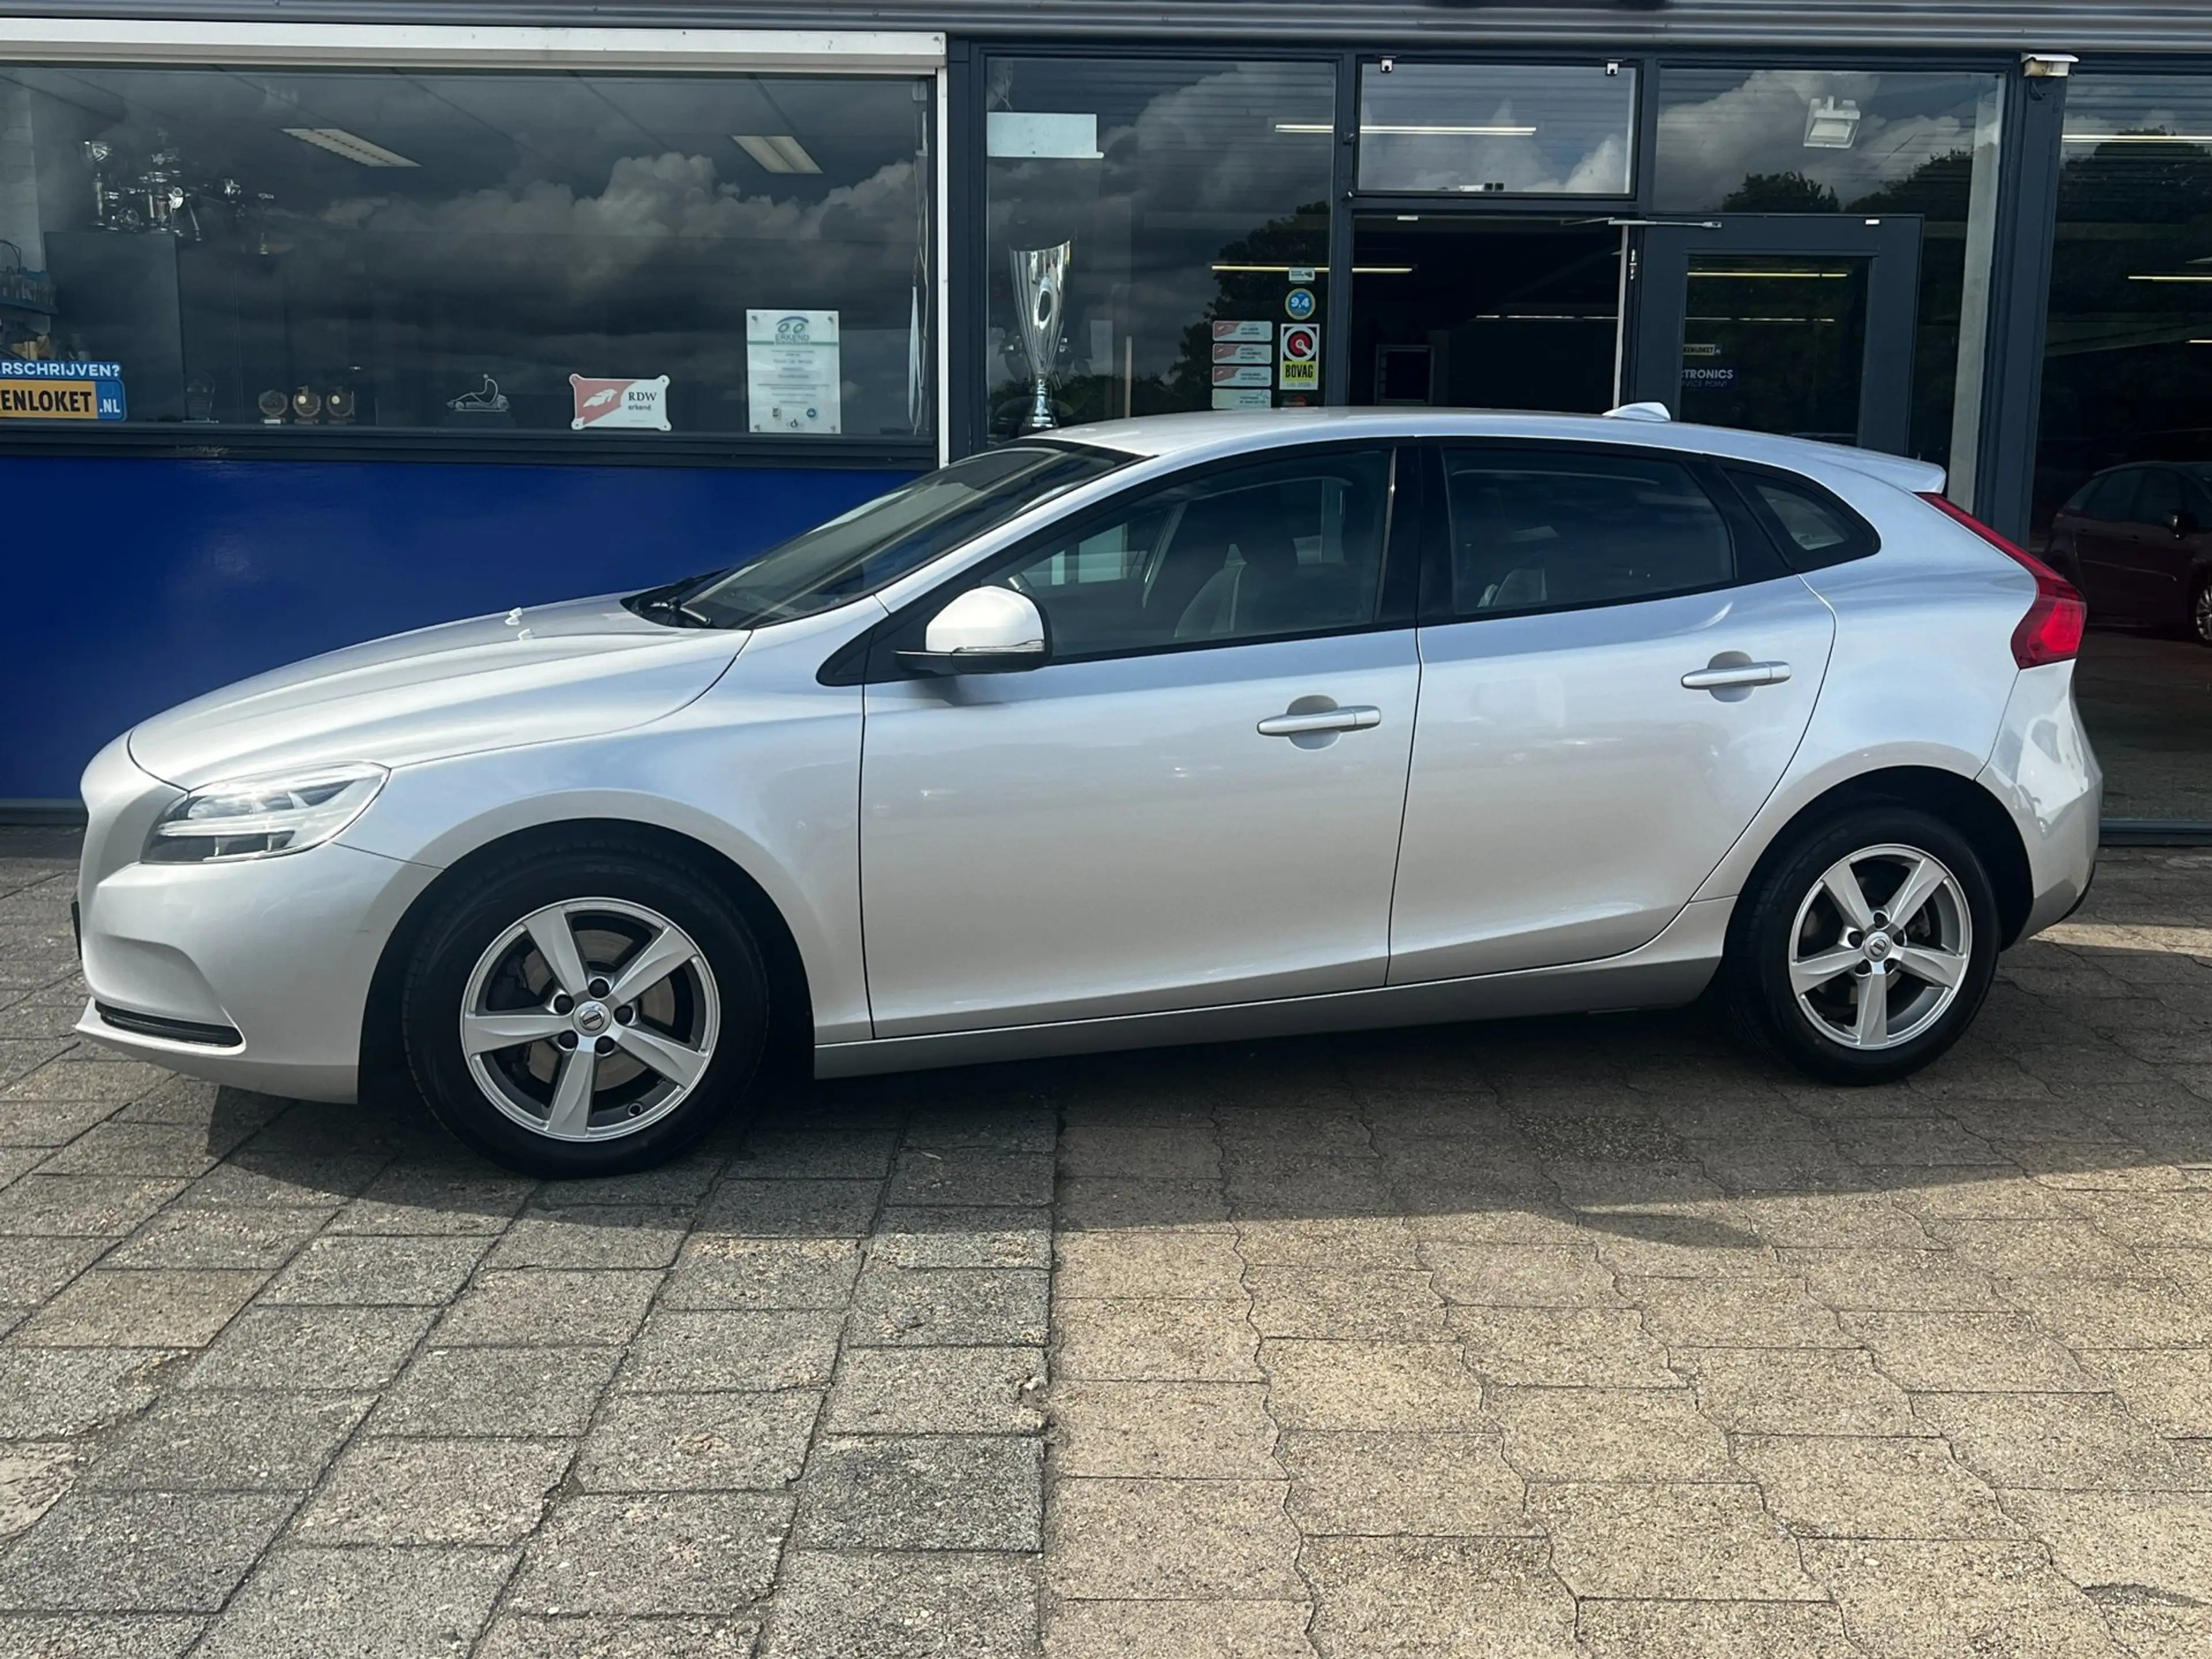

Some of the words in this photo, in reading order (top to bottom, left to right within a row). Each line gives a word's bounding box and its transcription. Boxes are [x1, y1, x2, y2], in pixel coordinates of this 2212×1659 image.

[1291, 297, 1310, 309] 9,4
[0, 362, 120, 377] RSCHRIJVEN?
[1285, 363, 1313, 378] BOVAG
[0, 389, 92, 412] ENLOKET
[628, 392, 657, 401] RDW
